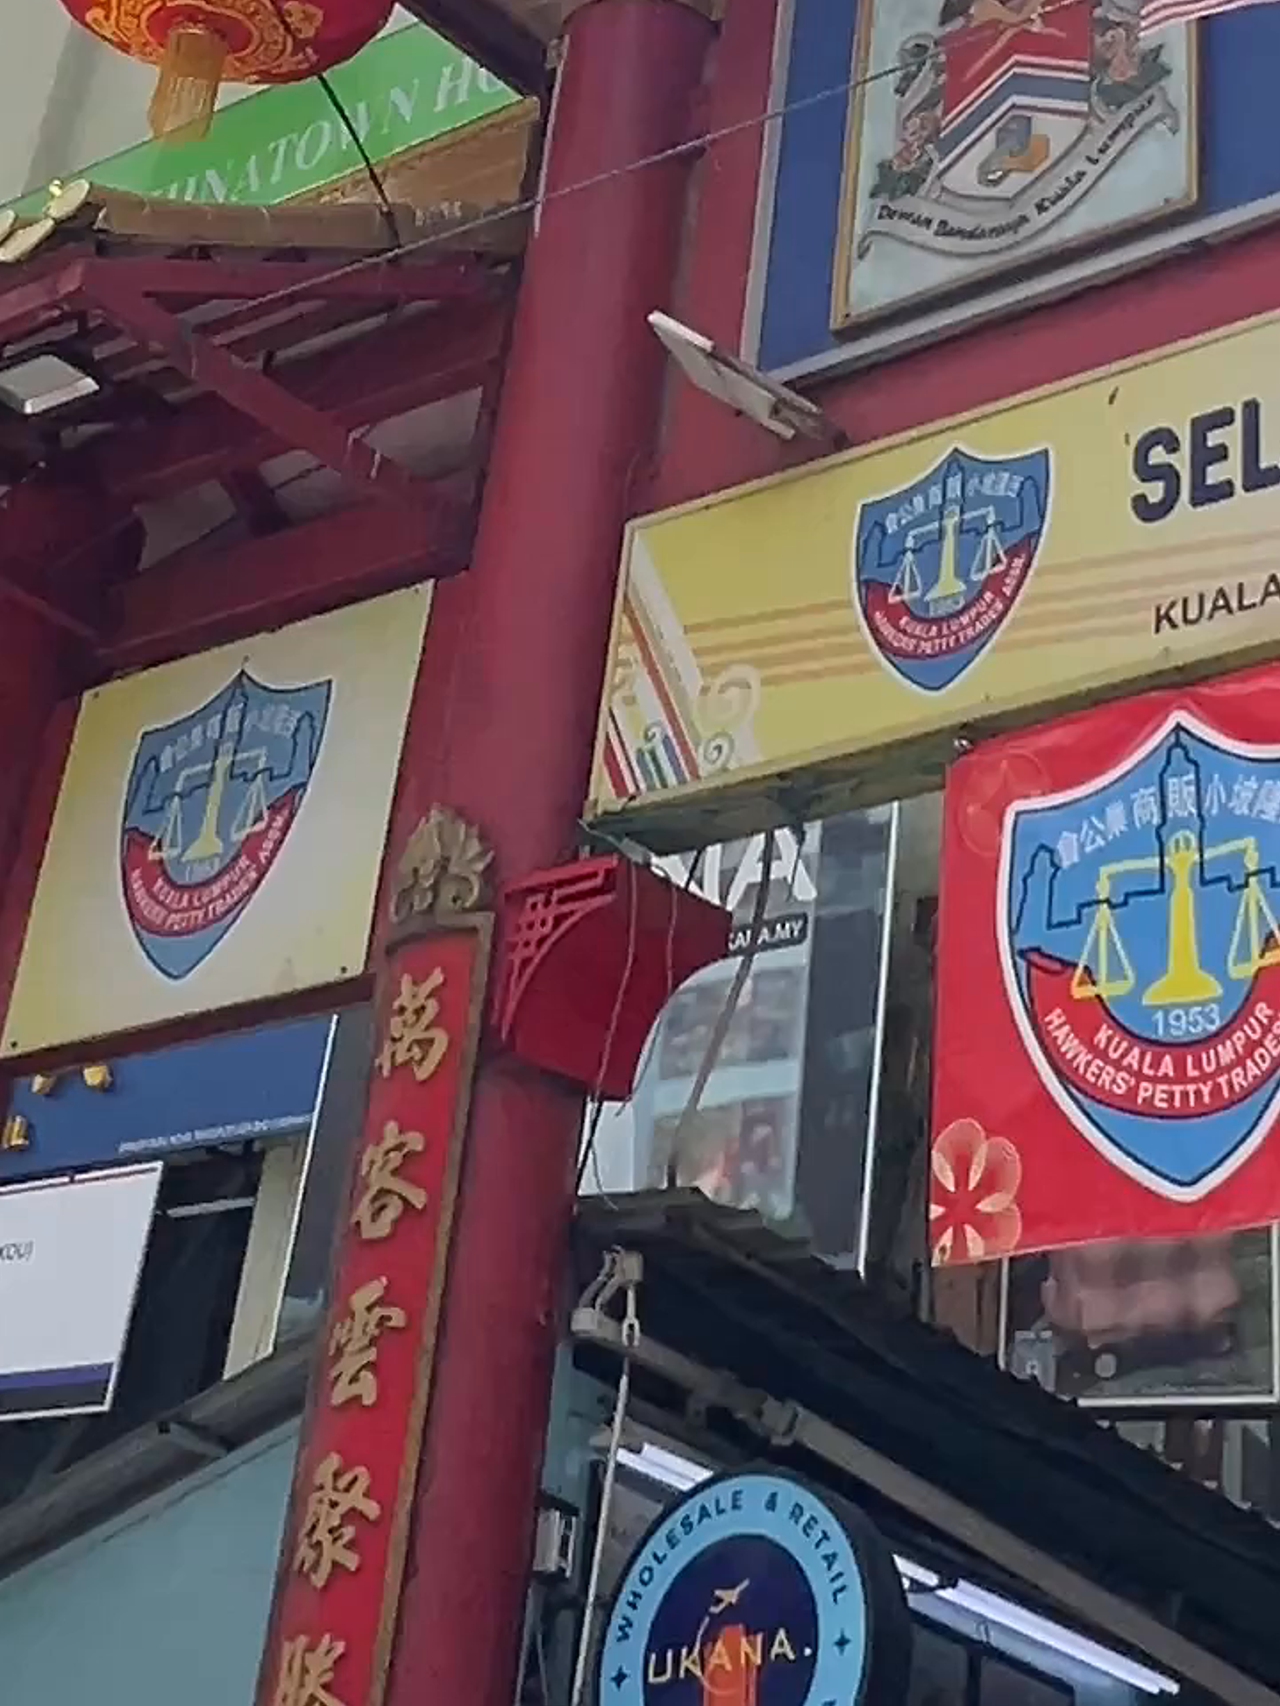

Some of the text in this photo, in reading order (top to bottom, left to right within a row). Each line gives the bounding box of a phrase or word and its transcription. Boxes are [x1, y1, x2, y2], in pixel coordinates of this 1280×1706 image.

[1093, 1001, 1275, 1079] KUALA LUMPUR
[1152, 1004, 1221, 1038] 1953
[1137, 1083, 1213, 1110] PETTY
[616, 1489, 848, 1643] WHOLESALE & RETAIL
